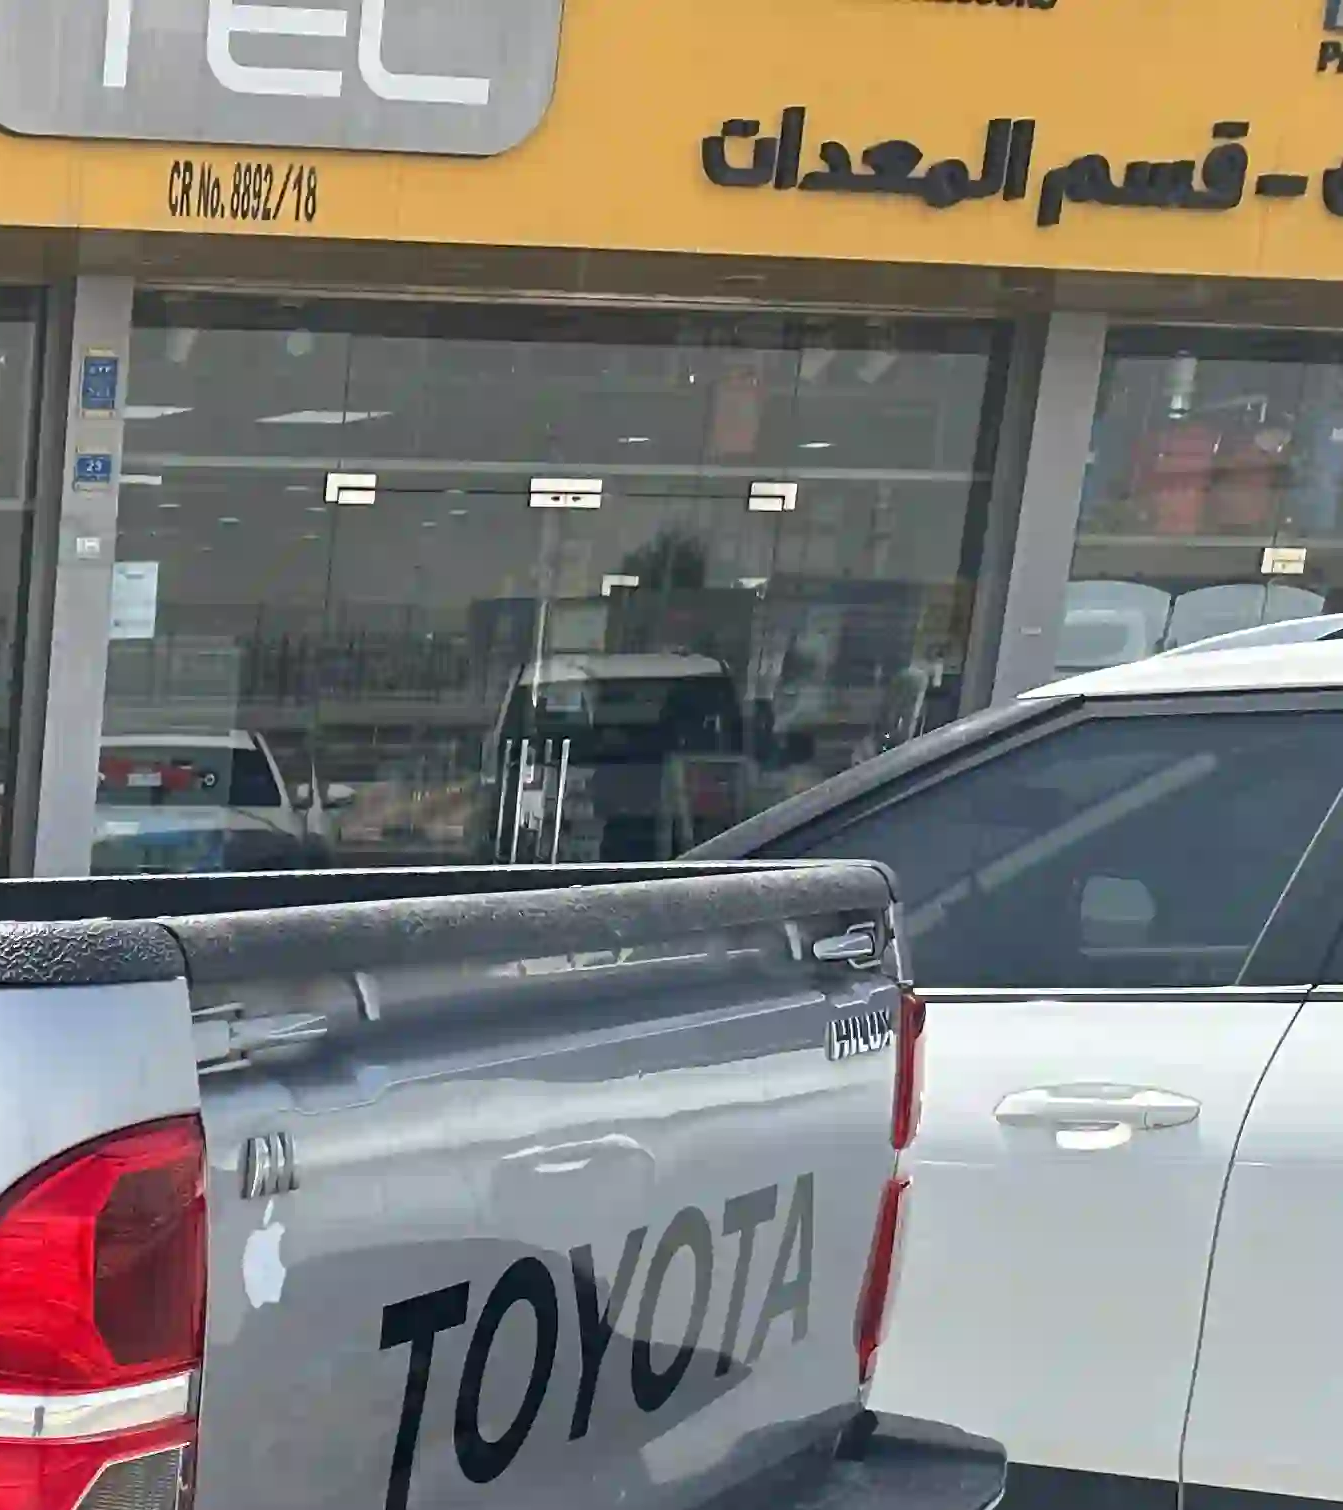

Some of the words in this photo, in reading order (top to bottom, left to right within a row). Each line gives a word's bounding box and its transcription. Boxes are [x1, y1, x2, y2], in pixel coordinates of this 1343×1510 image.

[169, 160, 193, 217] CR
[197, 162, 225, 219] No.
[230, 162, 317, 222] 8892/18
[702, 106, 1036, 209] المعدات
[1037, 121, 1250, 227] قسم
[829, 1006, 895, 1061] HILUX
